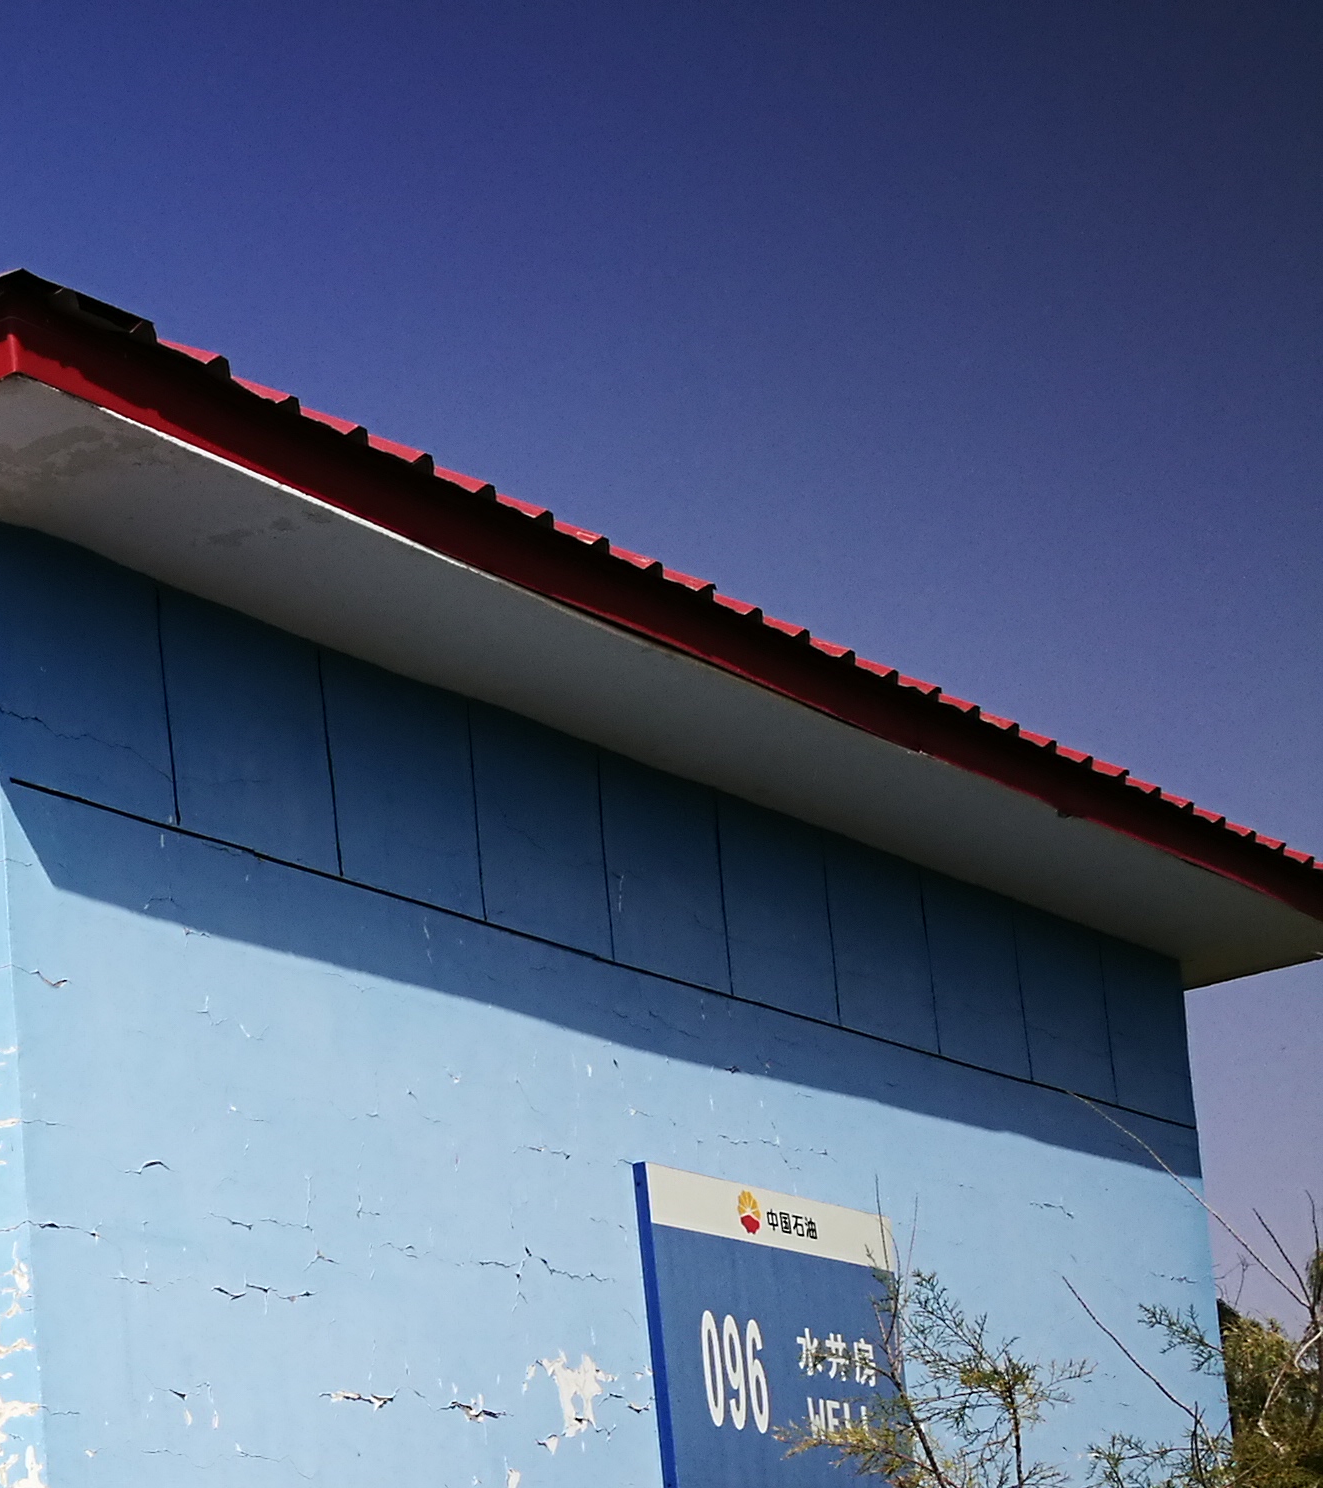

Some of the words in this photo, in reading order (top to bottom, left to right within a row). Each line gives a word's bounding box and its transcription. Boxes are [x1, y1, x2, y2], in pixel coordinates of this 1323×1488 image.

[766, 1208, 818, 1240] 中国石油
[700, 1310, 770, 1434] 096
[796, 1327, 877, 1388] 水井房
